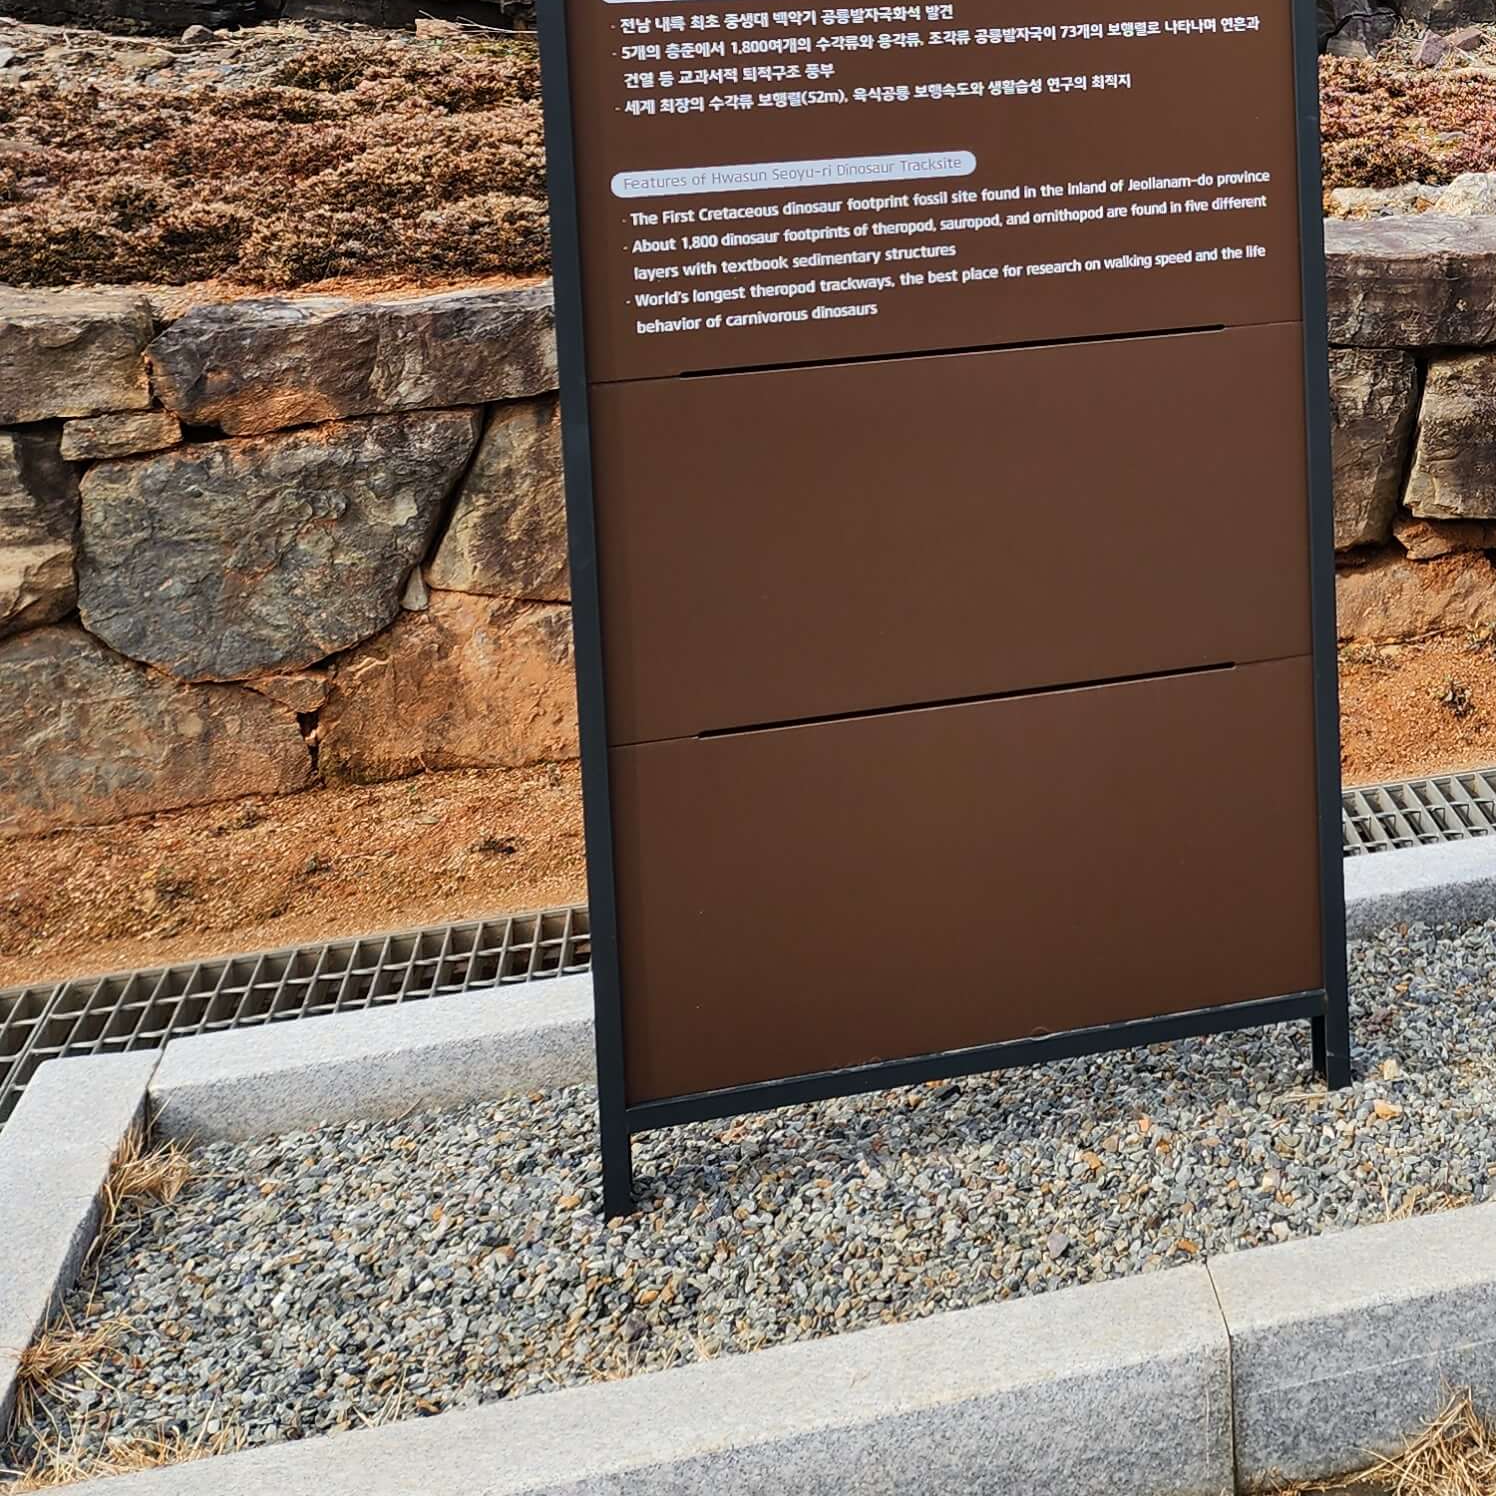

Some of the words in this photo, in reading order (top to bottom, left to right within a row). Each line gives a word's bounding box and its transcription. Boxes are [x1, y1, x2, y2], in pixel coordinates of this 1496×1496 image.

[620, 17, 650, 33] 전남
[655, 15, 685, 31] 내륙
[690, 14, 720, 29] 최초
[723, 12, 768, 29] 중생대
[773, 10, 816, 26] 백악기
[820, 6, 920, 24] 공룡발자국화석
[925, 4, 952, 20] 발견
[622, 44, 660, 60] 5개의
[665, 41, 724, 58] 층준에서
[816, 34, 874, 51] 수각류와
[928, 30, 970, 44] 조각류
[974, 26, 1055, 43] 공룡발자국이
[1060, 23, 1102, 38] 73개의
[1107, 21, 1160, 36] 보행렬로
[1165, 18, 1215, 34] 나타나며
[1220, 16, 1259, 31] 연흔과
[624, 72, 653, 88] 건열
[658, 70, 674, 86] 등
[678, 68, 737, 83] 교과서적
[743, 65, 801, 81] 퇴적구조
[805, 63, 834, 79] 풍부
[625, 99, 654, 114] 세계
[660, 96, 704, 113] 최장의
[708, 94, 753, 110] 수각류
[852, 85, 909, 101] 육식공룡
[913, 82, 984, 98] 보행속도와
[988, 78, 1041, 95] 생활습성
[1047, 76, 1086, 92] 연구의
[1091, 73, 1130, 89] 최적지
[623, 176, 686, 189] Features
[691, 172, 705, 185] of
[712, 171, 766, 184] Hwasun
[772, 164, 831, 181] Seoyu-ri
[836, 163, 894, 176] Dinosaur
[899, 157, 961, 171] Tracksite
[630, 212, 658, 225] The
[662, 209, 694, 223] First
[699, 205, 778, 220] Cretaceous
[783, 201, 842, 214] dinosaur
[847, 195, 908, 210] footprint
[913, 191, 947, 205] fossil
[952, 190, 977, 203] site
[981, 186, 1019, 200] found
[1024, 185, 1036, 198] in
[1040, 184, 1063, 196] the
[1068, 180, 1106, 194] inland
[1110, 179, 1123, 192] of
[1128, 174, 1213, 190] Jeollanam-do
[1217, 170, 1269, 186] province
[635, 291, 689, 306] World's
[693, 286, 745, 303] longest
[749, 280, 815, 297] theropod
[899, 272, 923, 285] the
[928, 269, 957, 283] best
[962, 267, 998, 283] place
[1002, 264, 1022, 277] for
[1026, 259, 1081, 274] research
[1084, 259, 1100, 270] on
[1104, 254, 1151, 268] walking
[1155, 250, 1191, 266] speed
[1195, 247, 1217, 261] and
[1221, 247, 1242, 259] the
[1246, 244, 1265, 257] life
